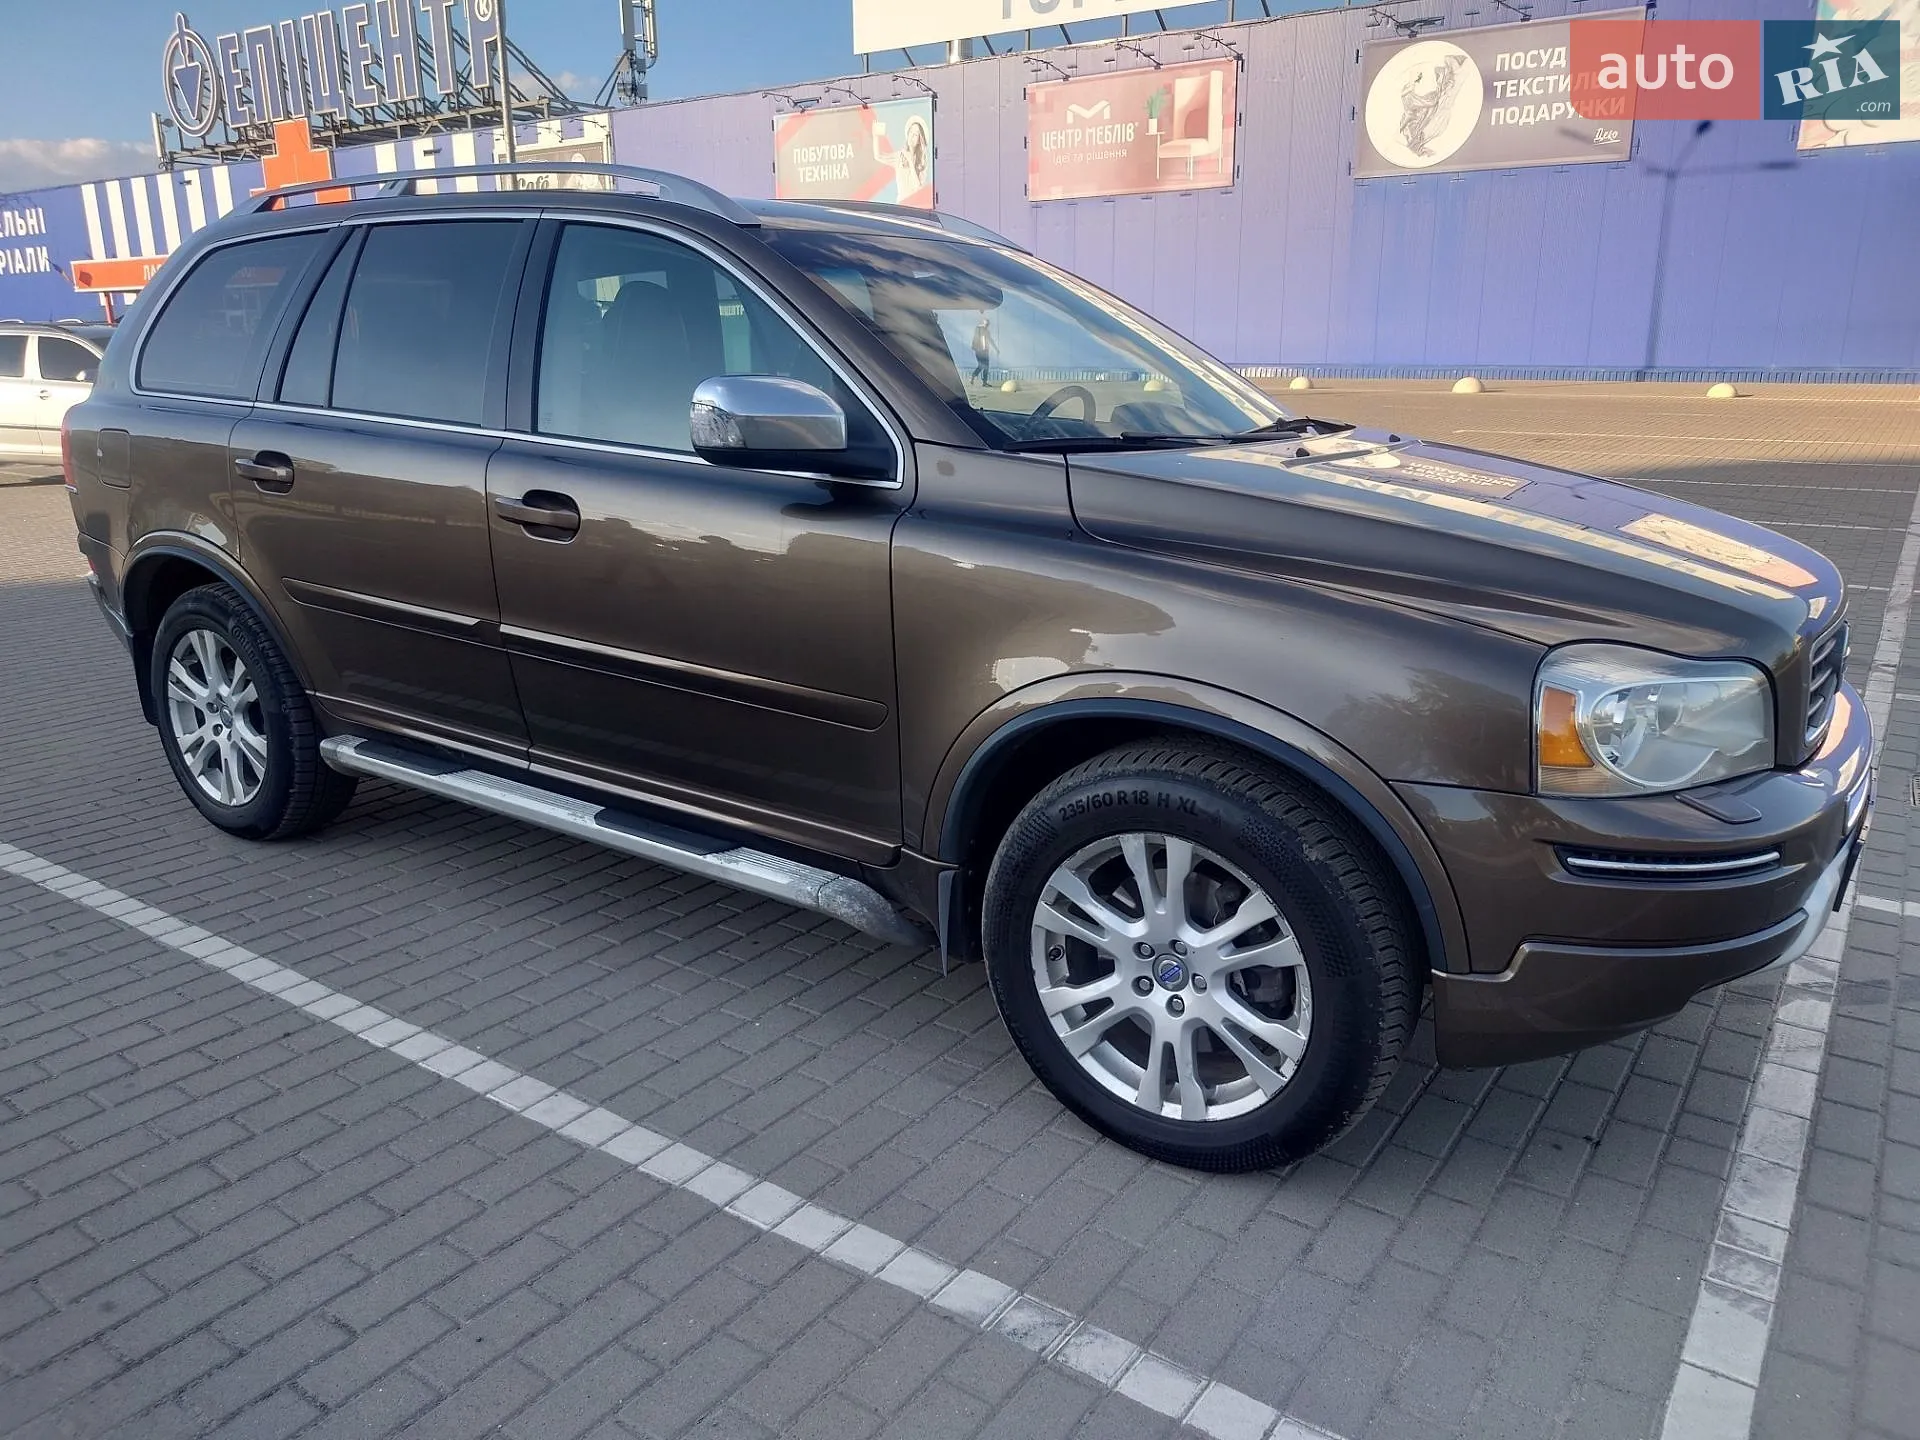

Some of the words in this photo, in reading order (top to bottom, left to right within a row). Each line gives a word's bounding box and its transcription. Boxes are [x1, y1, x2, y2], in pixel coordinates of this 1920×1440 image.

[218, 0, 498, 128] ЕПІЦЕНТР
[1495, 46, 1567, 72] ПОСУД
[1490, 97, 1626, 126] ПОДАРУНКИ
[1042, 128, 1082, 152] ЦЕНТР
[1085, 122, 1135, 146] МЕБЛІВ
[793, 143, 854, 164] ПОБУТОВА
[1073, 152, 1084, 161] та
[1086, 148, 1128, 164] рішення
[798, 163, 850, 183] ТЕХНІКА
[1058, 792, 1114, 822] 235/60
[1117, 790, 1129, 806] R
[1132, 790, 1150, 806] 18
[1157, 791, 1171, 808] H
[1177, 795, 1199, 816] XL
